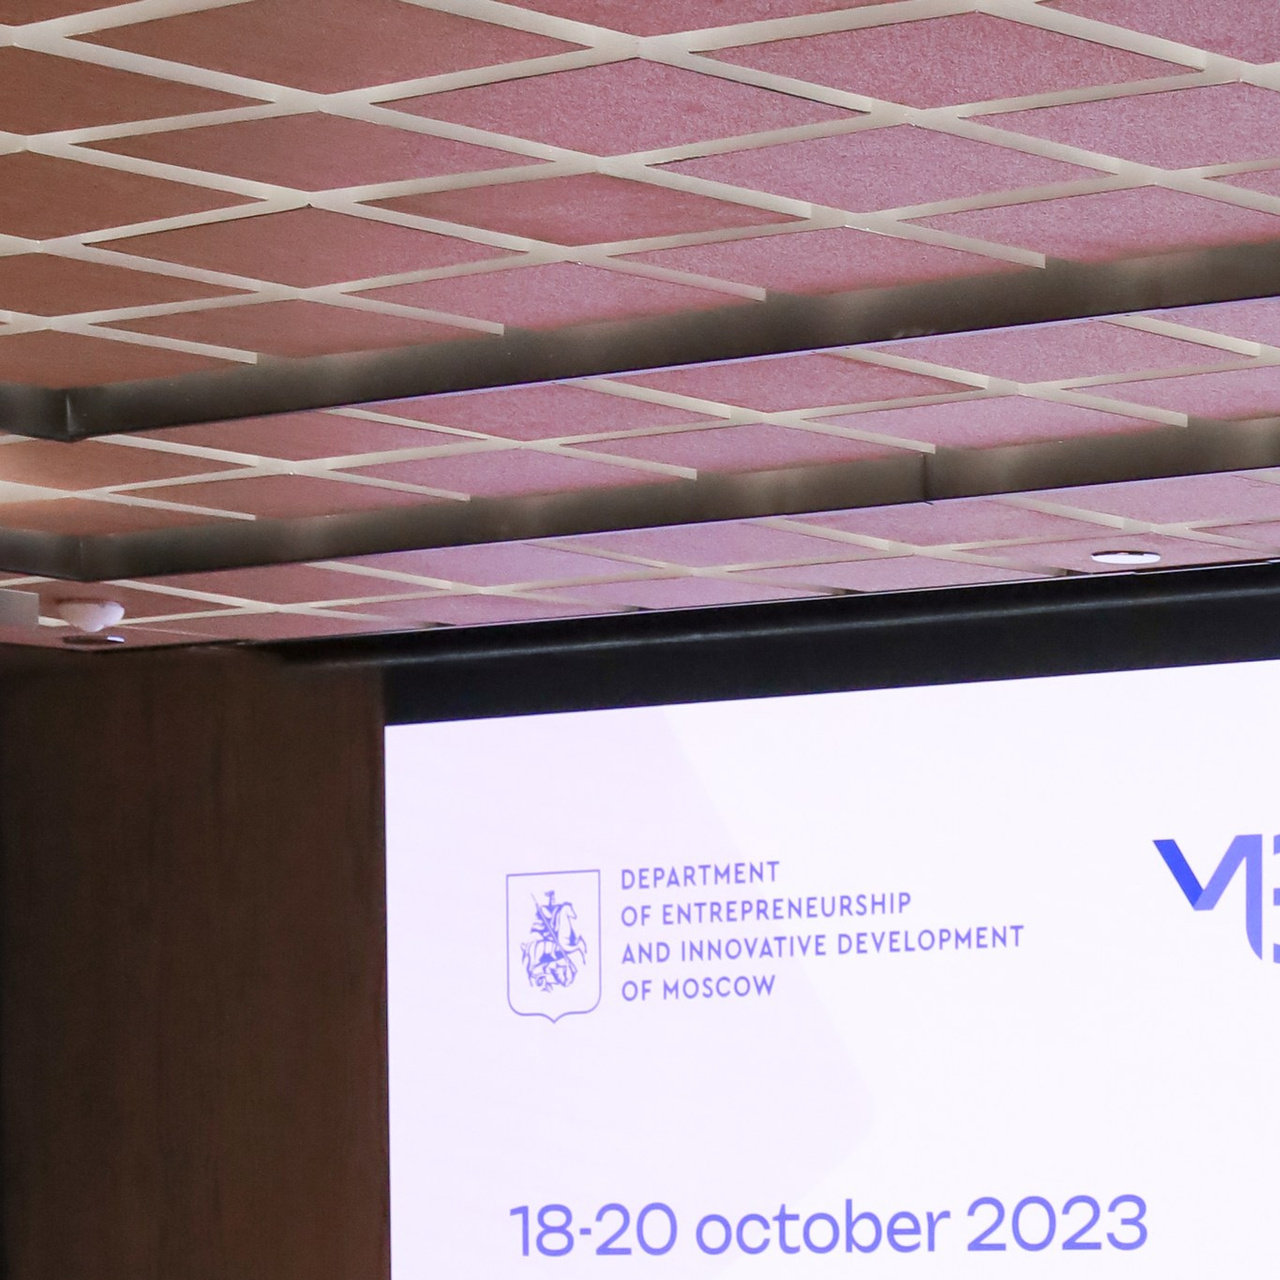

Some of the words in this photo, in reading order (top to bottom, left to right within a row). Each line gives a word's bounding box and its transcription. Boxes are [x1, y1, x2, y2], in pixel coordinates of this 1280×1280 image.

[621, 860, 781, 891] DEPARTMENT
[620, 905, 652, 928] OF
[661, 891, 912, 926] ENTREPRENEURSHIP
[621, 941, 671, 965] AND
[681, 933, 827, 962] INNOVATIVE
[837, 924, 1025, 956] DEVELOPMENT
[621, 979, 653, 1002] OF
[662, 974, 776, 1001] MOSCOW
[509, 1202, 678, 1258] 18-20
[695, 1198, 951, 1256] october
[967, 1194, 1148, 1252] 2023
